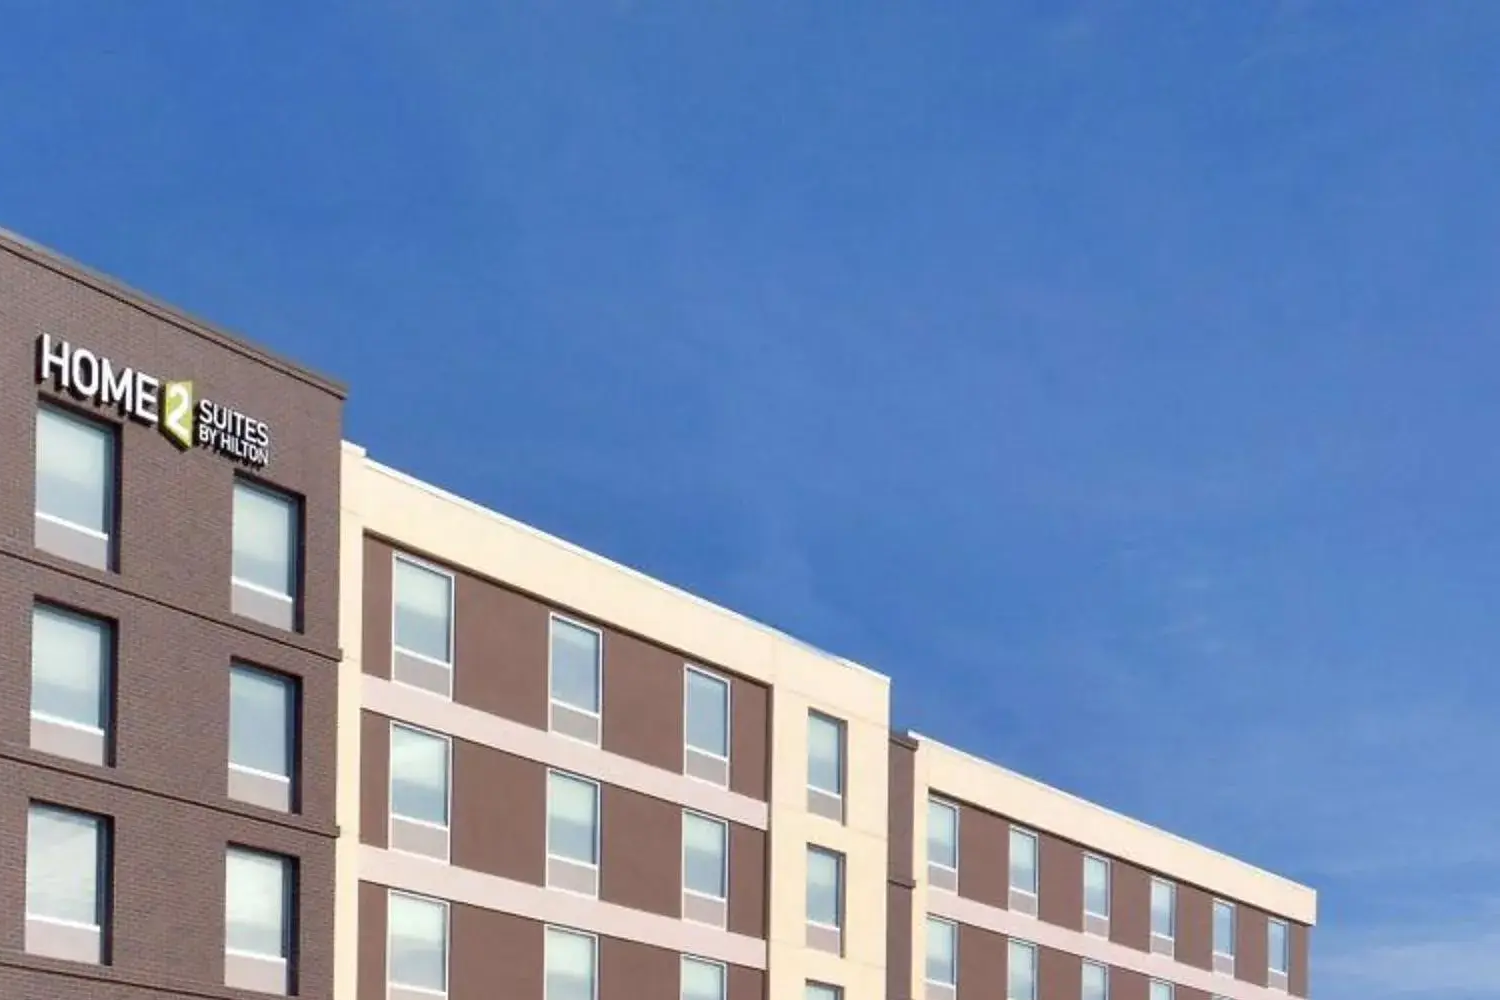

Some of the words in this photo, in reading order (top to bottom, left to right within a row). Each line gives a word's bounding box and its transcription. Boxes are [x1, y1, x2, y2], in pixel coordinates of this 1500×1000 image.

[41, 333, 159, 422] HOME
[166, 382, 192, 445] 2
[200, 399, 268, 446] SUITES
[200, 423, 217, 445] BY
[221, 431, 268, 465] HILTON
